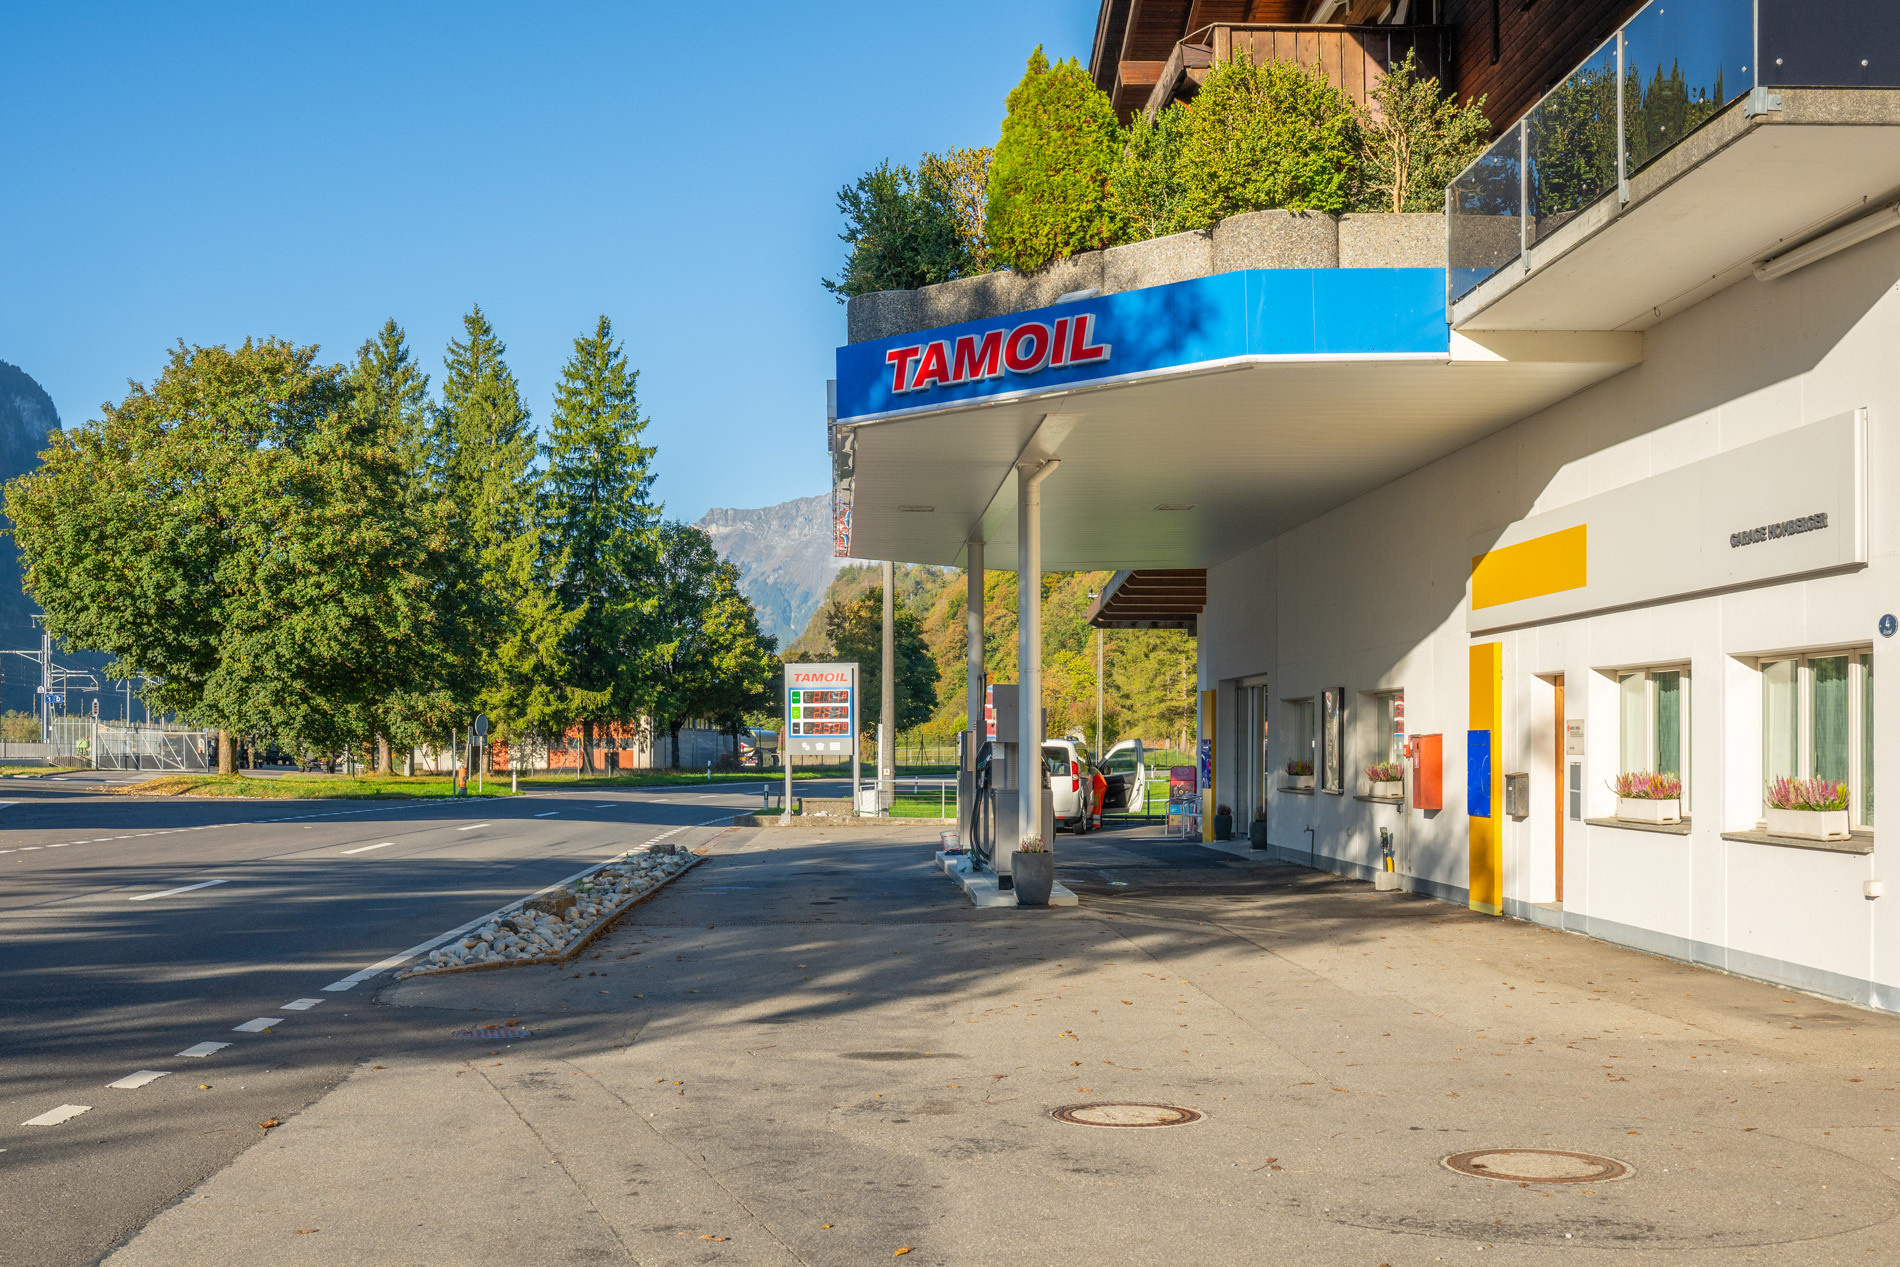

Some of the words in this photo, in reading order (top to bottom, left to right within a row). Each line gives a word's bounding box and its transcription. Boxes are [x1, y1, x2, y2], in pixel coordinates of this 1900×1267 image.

[885, 313, 1112, 394] TAMOIL
[1730, 525, 1767, 548] GARAGE
[1767, 512, 1828, 540] HOMBERGER
[794, 673, 848, 682] TAMOIL
